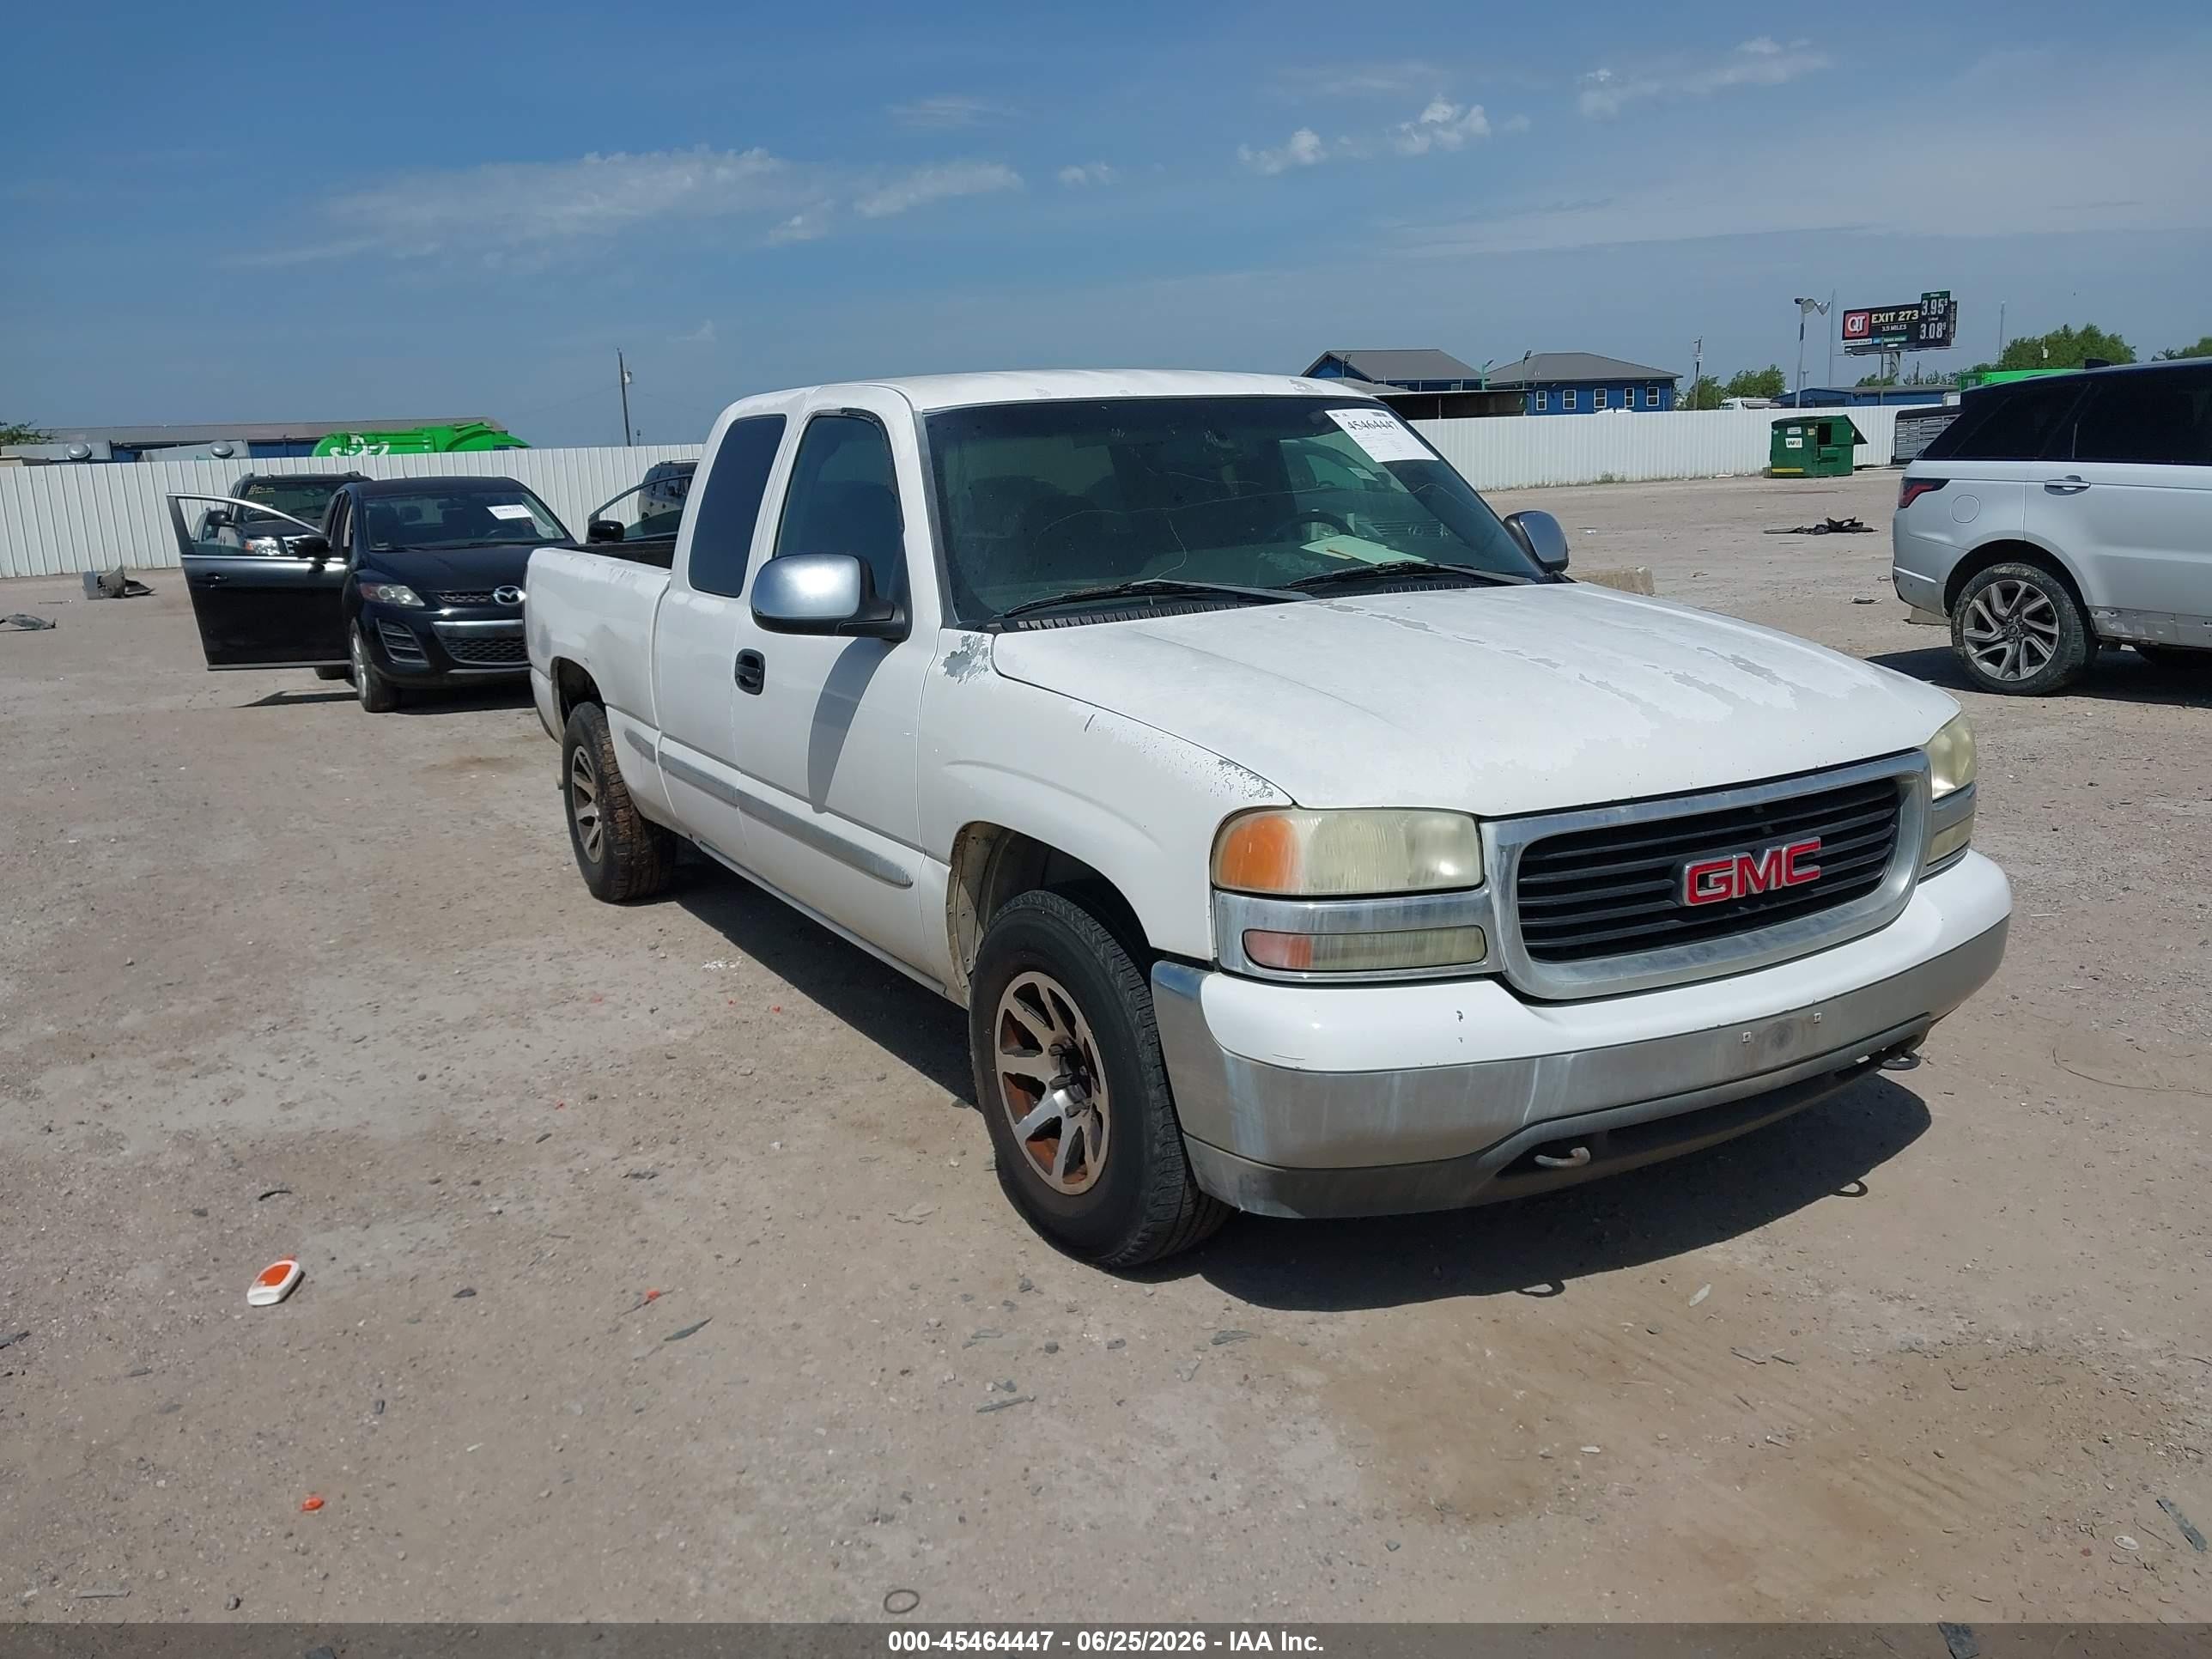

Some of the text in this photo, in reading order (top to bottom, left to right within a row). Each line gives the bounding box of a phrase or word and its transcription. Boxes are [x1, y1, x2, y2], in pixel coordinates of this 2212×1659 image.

[1847, 315, 1866, 333] QT
[1871, 309, 1919, 324] EXIT 273
[1346, 420, 1399, 431] 45464447
[1683, 836, 1820, 907] GMC
